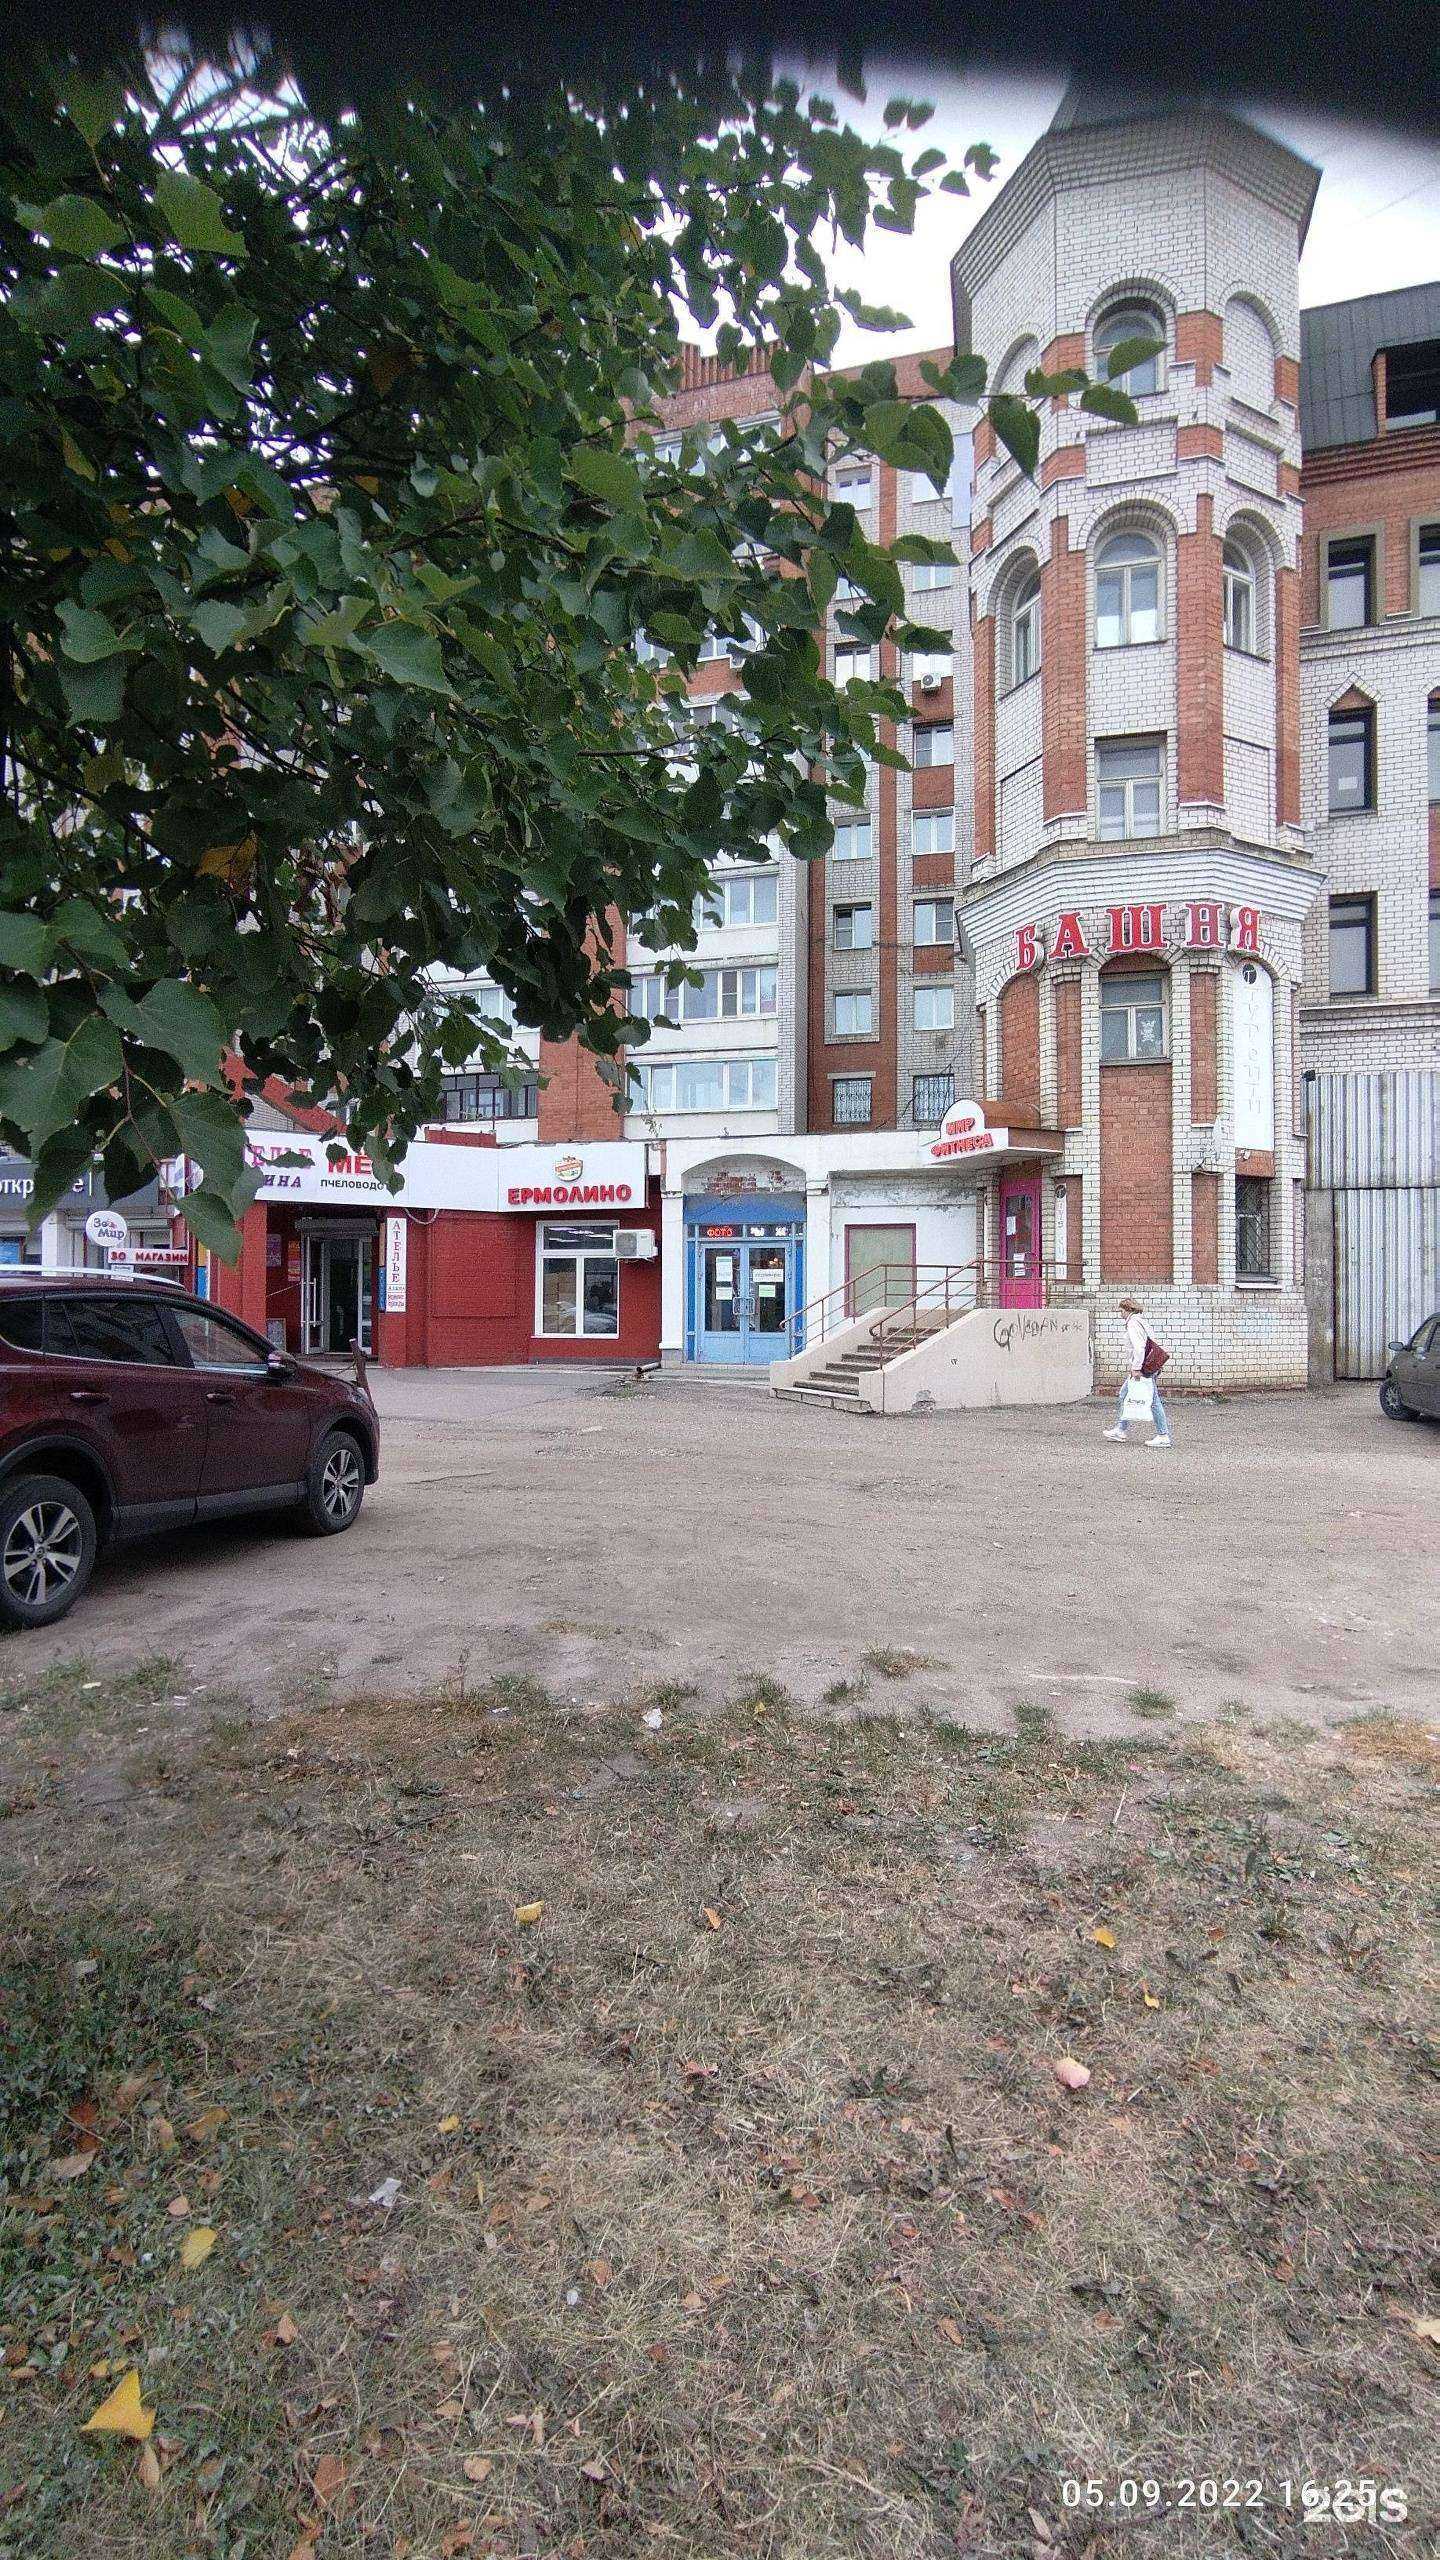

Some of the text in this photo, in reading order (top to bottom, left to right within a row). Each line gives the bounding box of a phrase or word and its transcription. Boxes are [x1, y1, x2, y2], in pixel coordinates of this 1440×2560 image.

[1014, 902, 1262, 970] БАШНЯ
[931, 1133, 994, 1157] ФИТНЕСА
[507, 1184, 632, 1205] ЕРМОЛИНО
[135, 1252, 188, 1262] МАГАЗИН
[391, 1220, 402, 1283] АТЕЛЬЕ
